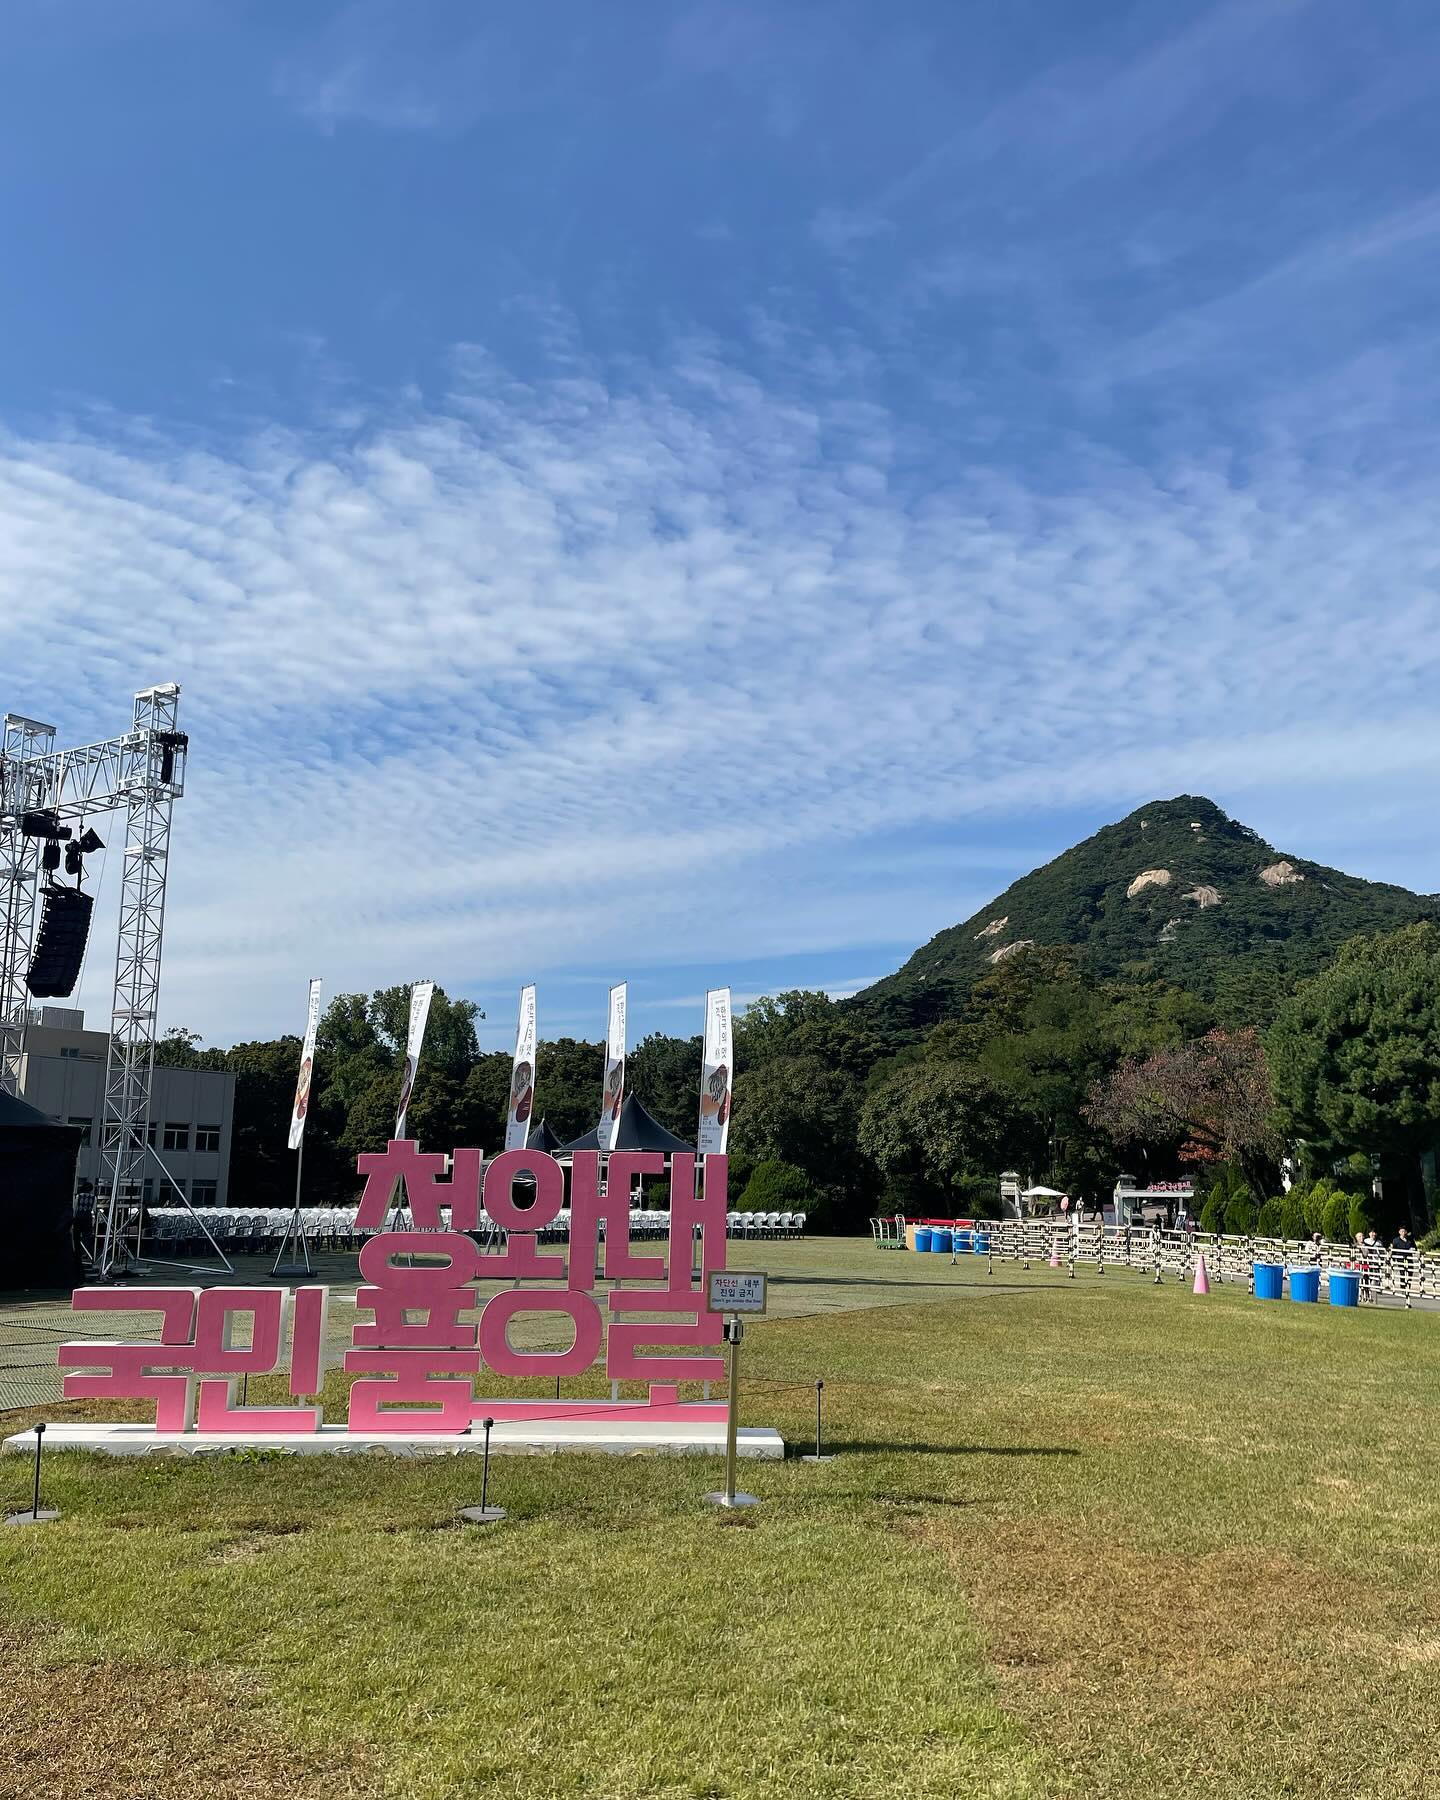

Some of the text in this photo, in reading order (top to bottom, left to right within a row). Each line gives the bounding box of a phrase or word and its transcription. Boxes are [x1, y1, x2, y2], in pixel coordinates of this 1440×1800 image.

[354, 1139, 728, 1292] 청와대
[714, 1279, 760, 1288] 차단선 내부
[720, 1288, 754, 1298] 진입 금지
